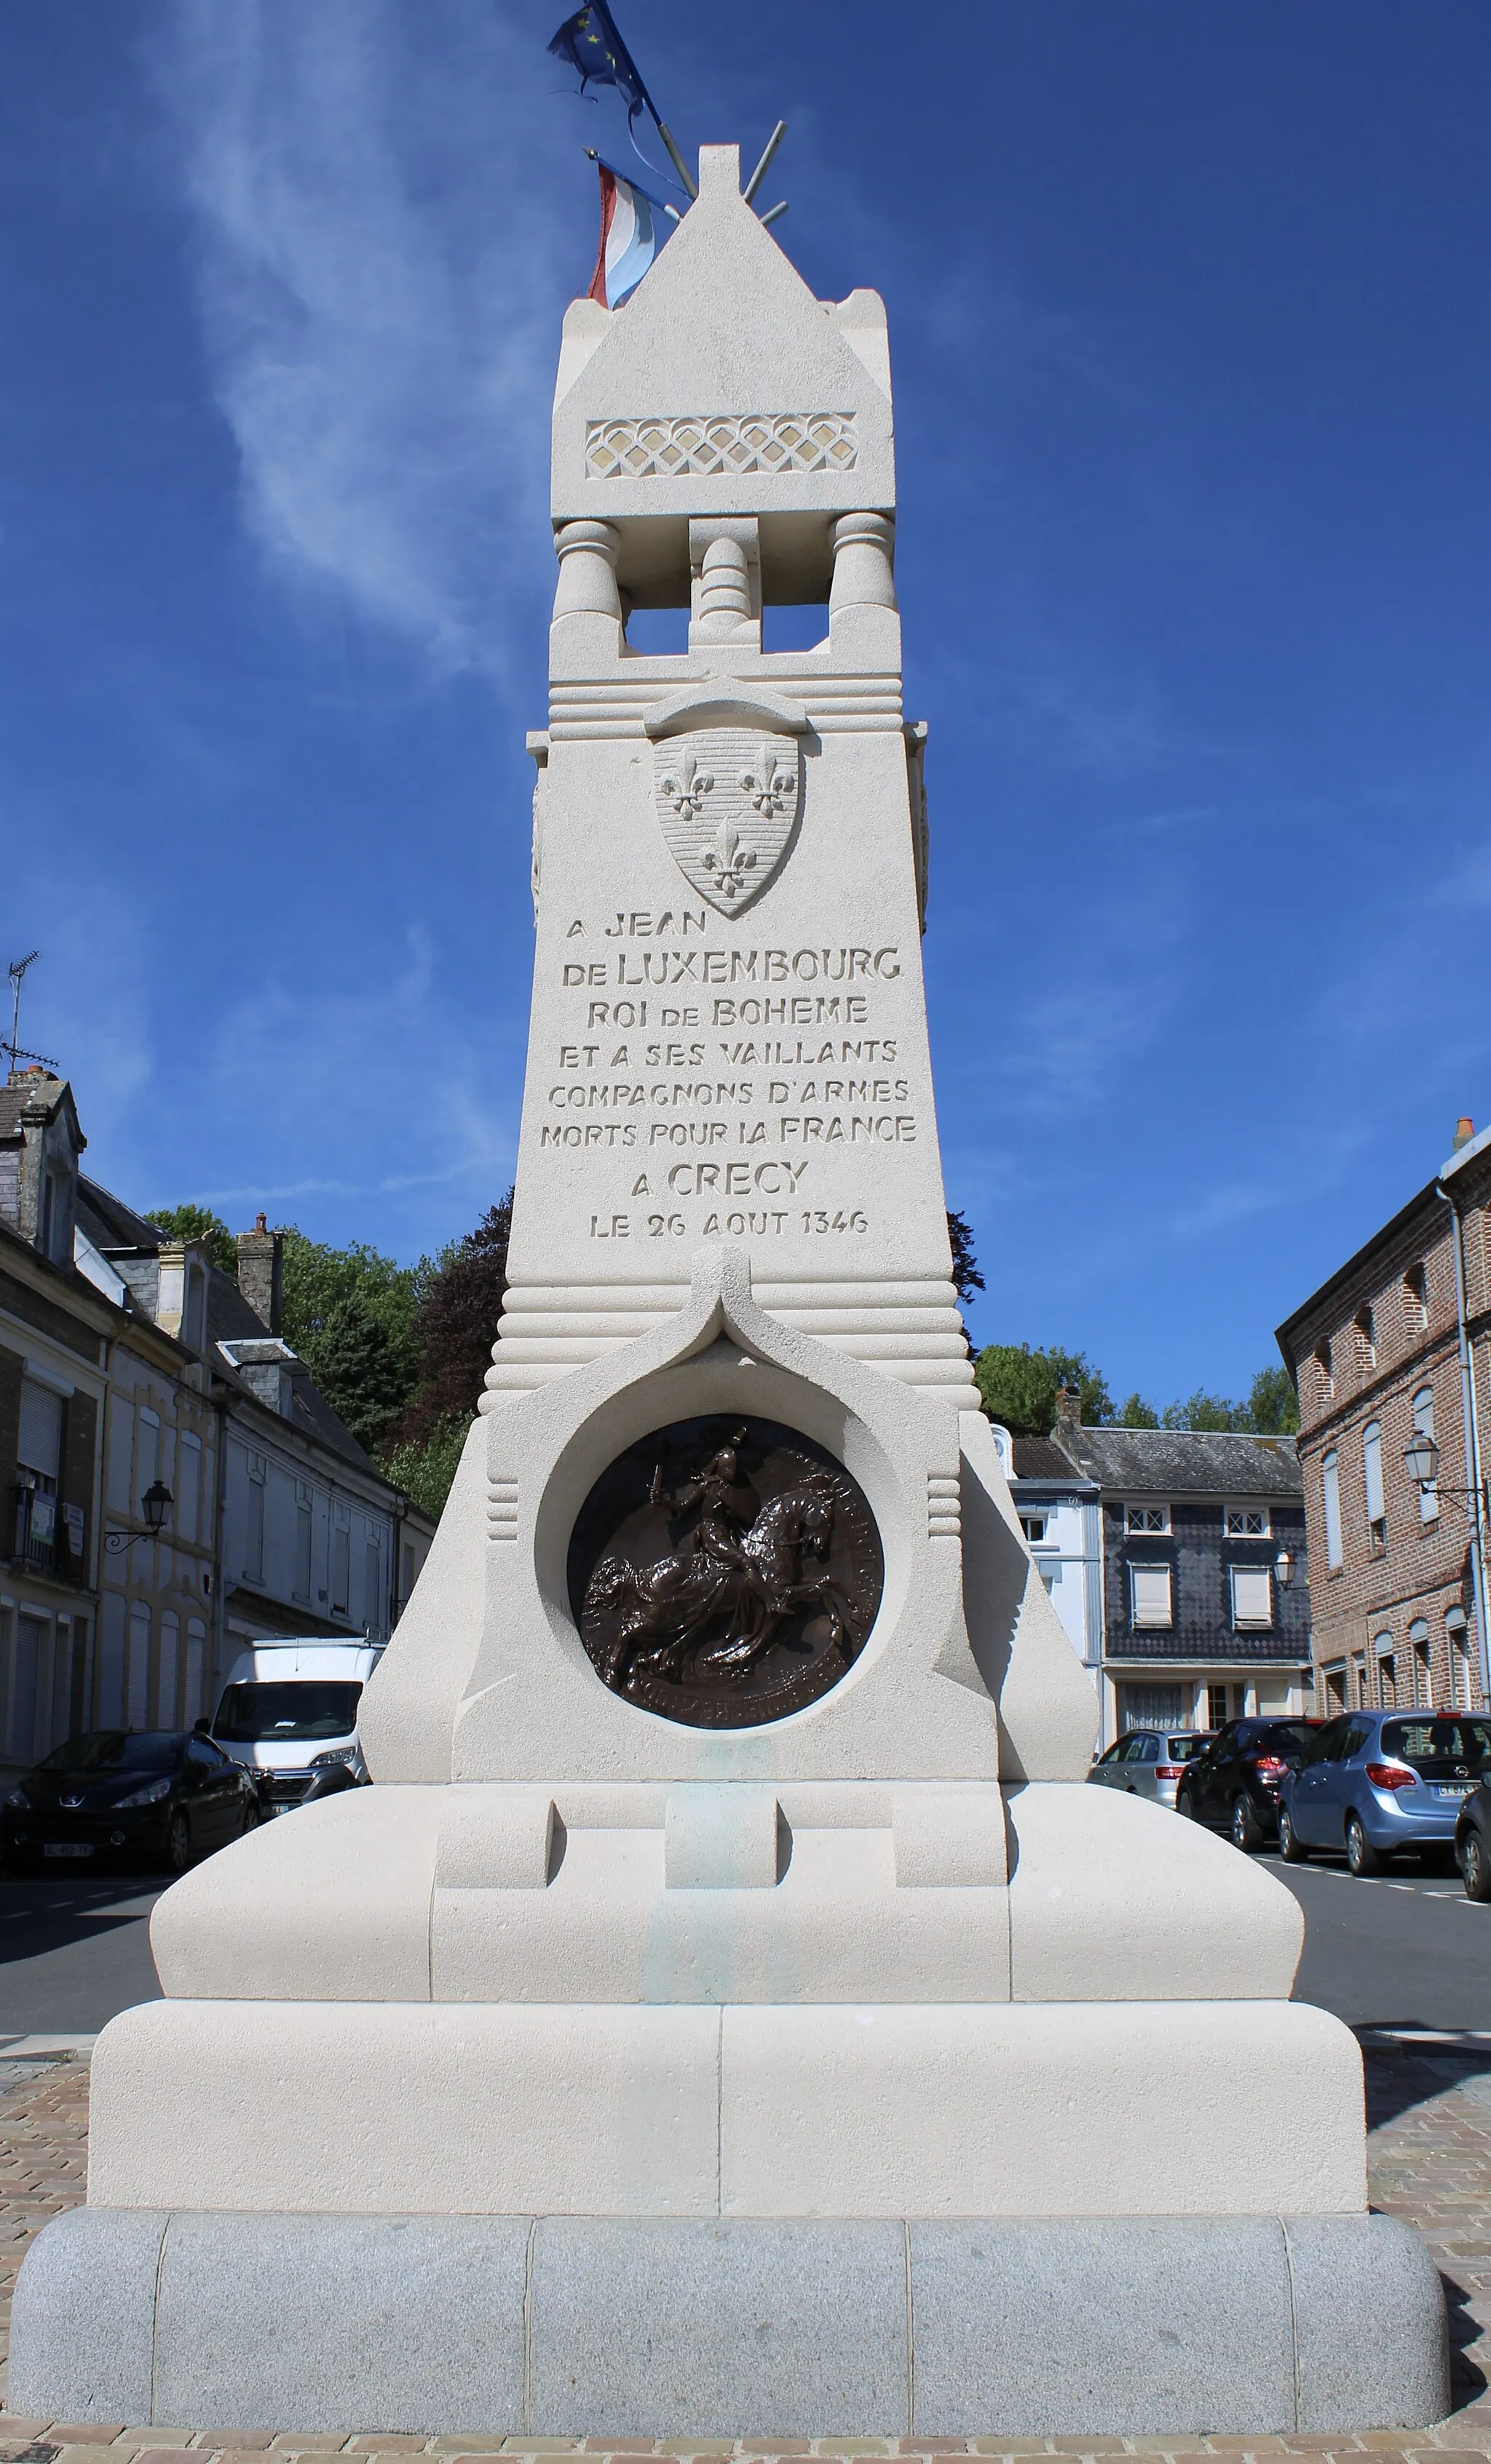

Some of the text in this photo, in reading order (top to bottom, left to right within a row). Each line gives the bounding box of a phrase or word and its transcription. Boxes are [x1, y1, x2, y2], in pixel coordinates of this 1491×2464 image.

[566, 911, 706, 938] A JEAN
[562, 947, 902, 986] DE LUXEMBOURG
[588, 996, 869, 1029] ROI DE BOHEME
[559, 1040, 897, 1068] ET A SES VAILLANTS
[548, 1080, 909, 1108] COMPAGNONS D'ARMES
[540, 1116, 917, 1147] MORTS POUR LA FRANCE
[630, 1161, 809, 1197] A CRECY
[590, 1211, 869, 1237] LE 26 AOUT 1346
